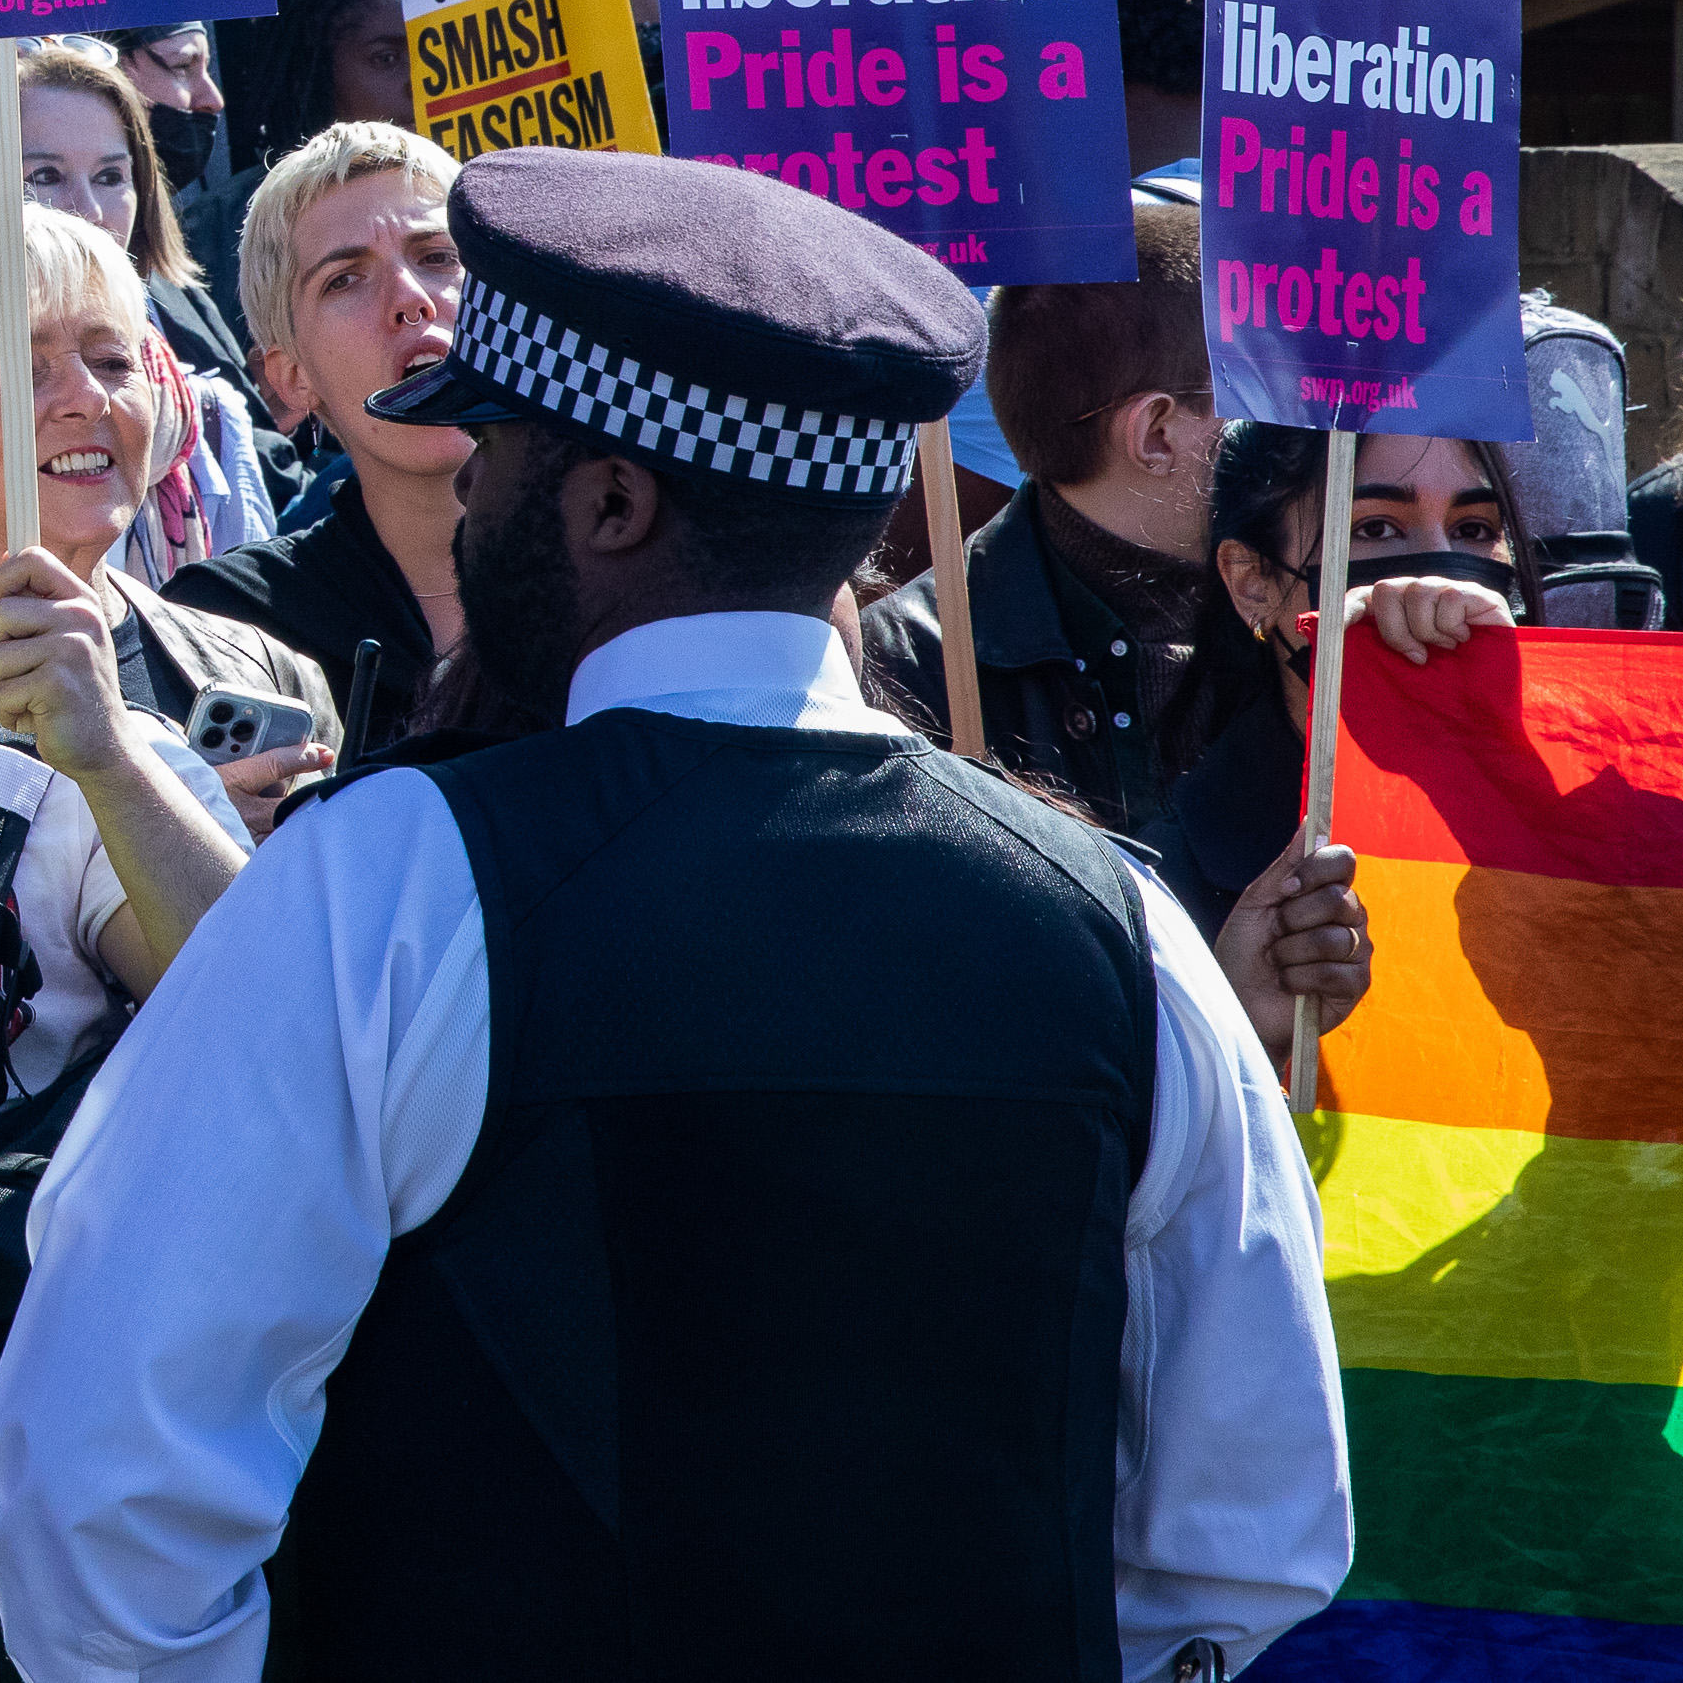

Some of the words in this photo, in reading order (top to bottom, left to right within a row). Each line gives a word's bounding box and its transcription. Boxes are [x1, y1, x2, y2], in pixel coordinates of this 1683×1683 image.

[685, 28, 907, 111] Pride
[936, 25, 1008, 103] is
[1038, 41, 1087, 100] a
[1222, 1, 1494, 123] liberation
[693, 127, 1000, 209] otest
[1218, 115, 1379, 224] Pride
[1396, 137, 1440, 231] is
[1459, 170, 1493, 236] a
[1218, 246, 1426, 345] protest
[1300, 372, 1418, 413] swp.org.uk
